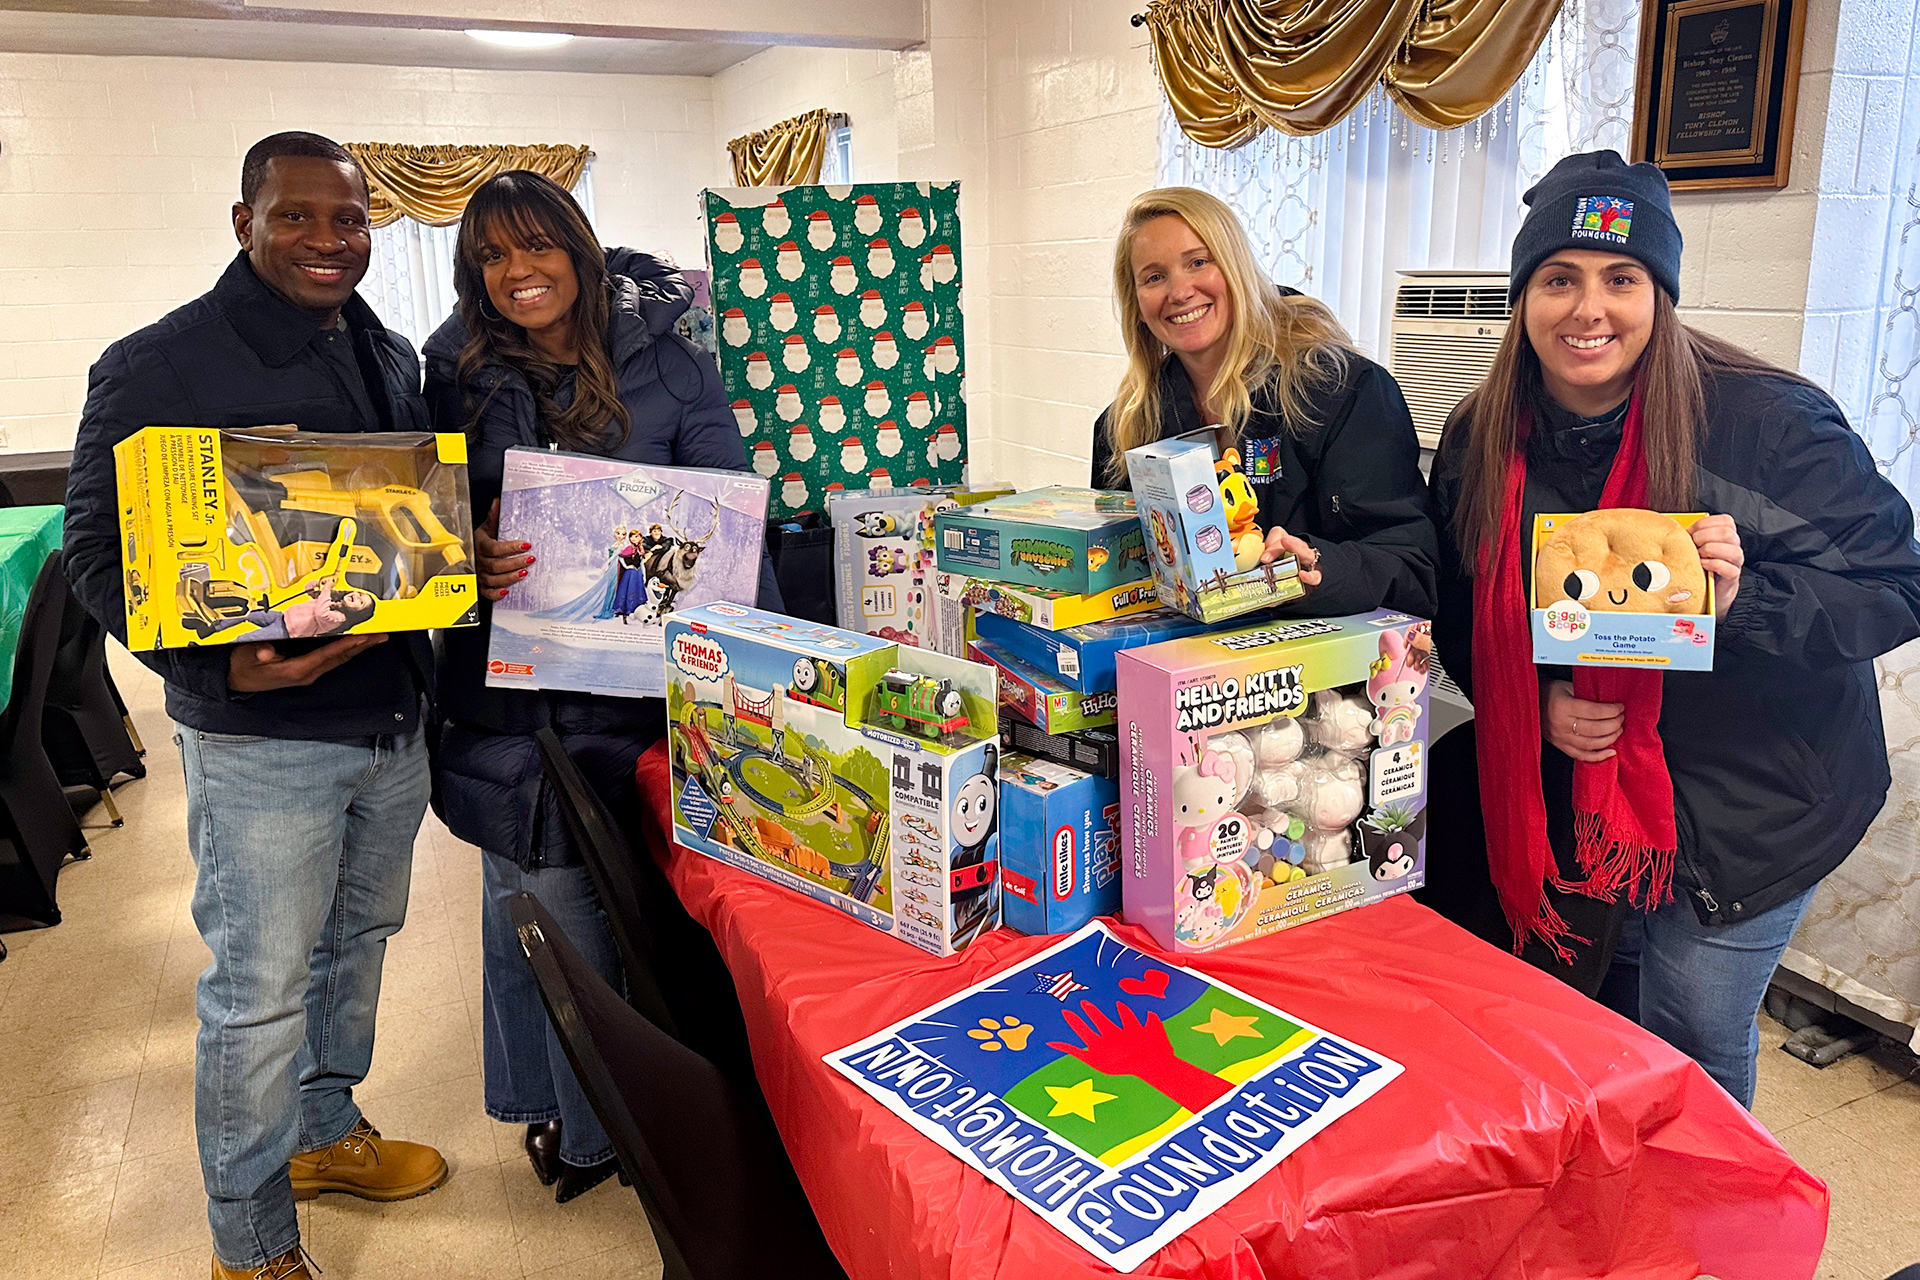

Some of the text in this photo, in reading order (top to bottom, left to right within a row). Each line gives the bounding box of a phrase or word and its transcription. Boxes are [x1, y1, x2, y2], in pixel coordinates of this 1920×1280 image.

[1683, 53, 1753, 68] Bishop Tony Clemon
[1698, 110, 1726, 119] BISHOP
[1684, 118, 1739, 129] TONY CLEMON
[1676, 127, 1745, 139] FELLOWSHIP HALL
[803, 187, 812, 195] HO
[803, 195, 814, 203] HO!
[751, 227, 759, 235] HO
[942, 229, 952, 237] HO!
[159, 434, 168, 453] JUEGO
[186, 434, 194, 454] WATER
[161, 453, 168, 461] DE
[170, 440, 178, 467] PRESSION
[161, 462, 171, 488] LIMPIEZA
[176, 434, 188, 504] ENSEMBLE DE NETTOYAGE
[187, 454, 196, 481] PRESSURE
[199, 434, 219, 526] STANLEY Jr.
[164, 488, 172, 501] CON
[189, 482, 198, 510] CLEANING
[619, 482, 657, 495] FROZEN
[165, 501, 173, 518] AGUA
[167, 524, 175, 548] PRESIÓN
[842, 522, 851, 557] FIGURAS
[1020, 551, 1067, 567] DINOSAUR
[451, 584, 466, 594] 5
[844, 563, 854, 604] FIGURINES
[1236, 579, 1267, 592] Winnie
[1248, 586, 1272, 599] Pooh
[863, 598, 873, 606] 4
[1112, 592, 1130, 609] Full
[467, 611, 476, 622] 3+
[1547, 610, 1587, 623] Giggle
[1210, 618, 1329, 647] HELLO KITTY
[1227, 623, 1345, 651] AND FRIENDS
[1594, 633, 1611, 641] Toss
[1629, 634, 1656, 643] Potato
[677, 640, 722, 664] THOMAS
[680, 653, 719, 673] & FRIENDS
[1175, 664, 1304, 709] HELLO KITTY
[890, 696, 898, 710] 6
[1053, 696, 1067, 708] MB
[1176, 685, 1305, 730] AND FRIENDS
[867, 730, 901, 745] MOTORIZED
[1393, 751, 1401, 763] 4
[1383, 762, 1414, 776] CERAMICS
[1381, 771, 1415, 786] CÉRAMIQUE
[1380, 781, 1415, 796] CERÁMICAS
[894, 790, 940, 810] COMPATIBLE
[1145, 768, 1154, 838] CERAMICS
[1218, 820, 1241, 839] 20
[1216, 841, 1243, 852] PEINTURES!
[1220, 836, 1239, 844] PAINTS!
[1081, 809, 1092, 894] Show us how you
[718, 847, 734, 860] Percy
[783, 871, 799, 885] Percy
[1059, 832, 1069, 893] little tikes
[1091, 830, 1114, 890] play
[1005, 881, 1026, 897] de Golf
[1285, 880, 1332, 902] CERAMICS
[1407, 880, 1416, 888] 100
[1344, 899, 1354, 909] 100
[871, 911, 884, 925] 3+
[910, 925, 919, 933] cm
